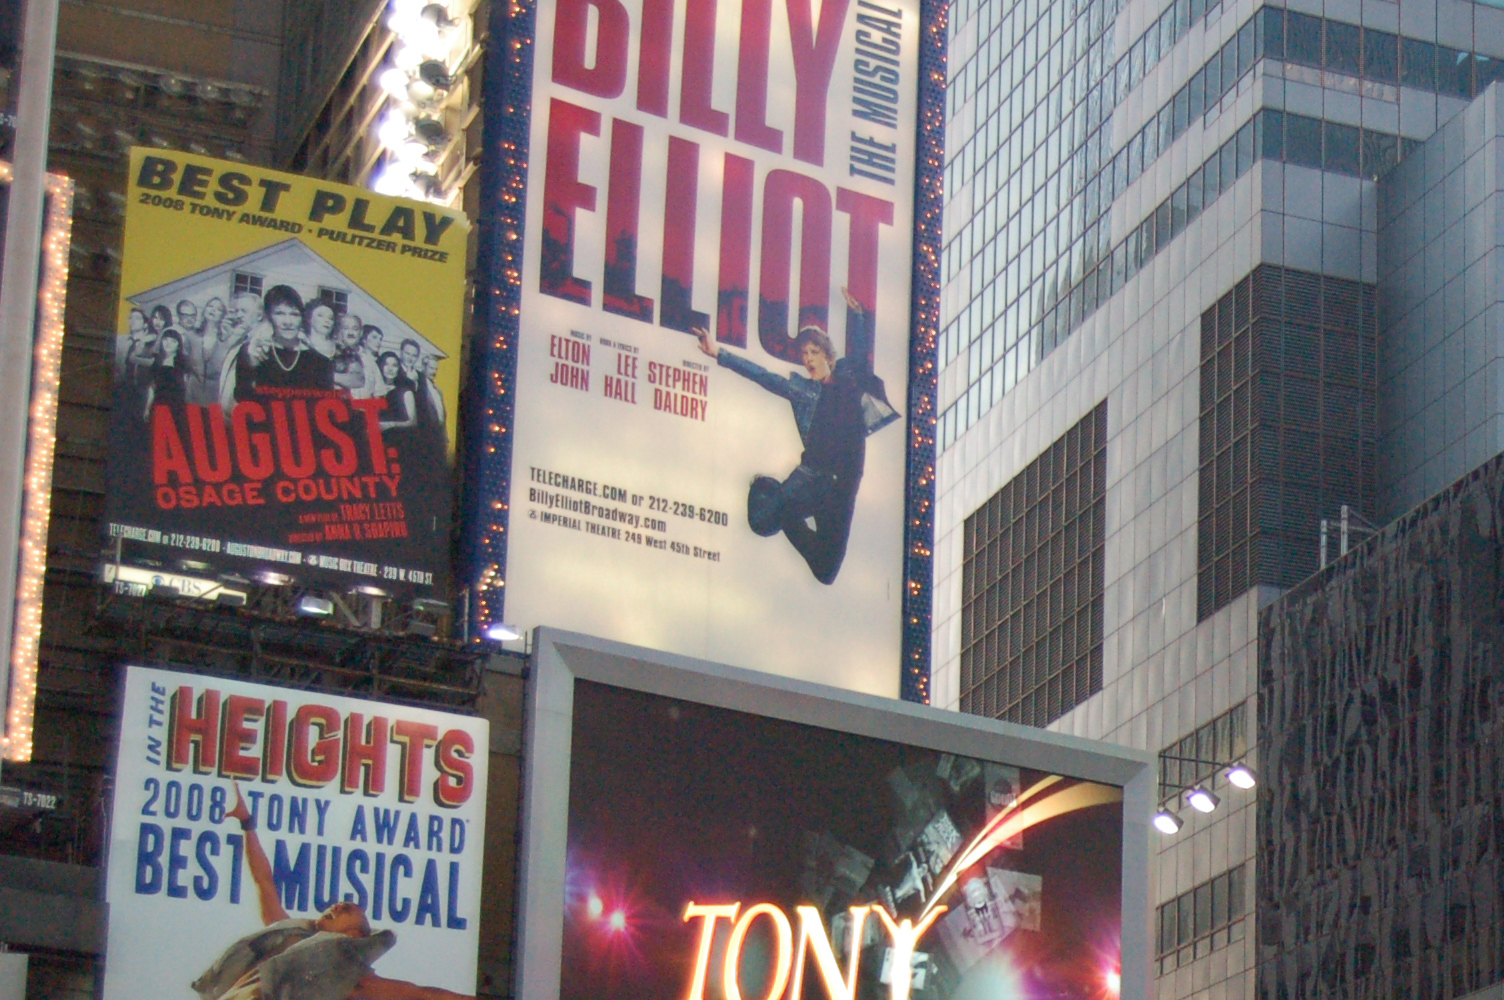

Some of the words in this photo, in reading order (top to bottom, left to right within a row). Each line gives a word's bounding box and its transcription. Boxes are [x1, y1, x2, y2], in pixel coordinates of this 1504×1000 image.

[852, 0, 902, 130] MUSICAL
[849, 130, 896, 186] THE
[137, 156, 291, 213] BEST
[308, 190, 455, 246] PLAY
[139, 193, 184, 212] 2008
[189, 202, 236, 221] TONY
[238, 212, 303, 234] AWARD
[317, 227, 398, 254] PULITZER
[400, 244, 449, 264] PRIZE
[539, 97, 895, 372] ELLIOT
[550, 334, 590, 366] ELTON
[617, 352, 638, 379] LEE
[550, 362, 589, 391] JOHN
[604, 374, 637, 405] HALL
[648, 361, 708, 397] STEPHEN
[654, 387, 708, 422] DALDRY
[152, 397, 401, 484] AUGUST:
[156, 482, 266, 509] OSAGE
[276, 475, 400, 502] COUNTY
[529, 487, 666, 532] BillyElliotBroadway.com
[530, 466, 627, 503] TELECHARGE.COM
[632, 493, 644, 506] or
[648, 496, 728, 527] 212-239-6200
[540, 511, 581, 531] IMPERIAL
[585, 521, 621, 540] THEATRE
[645, 535, 667, 550] West
[670, 541, 690, 556] 45th
[693, 546, 720, 562] Street
[148, 681, 166, 728] THE
[145, 735, 162, 766] IN
[166, 686, 475, 808] HEIGHTS
[140, 777, 227, 824] 2008
[247, 789, 331, 837] TONY
[350, 804, 466, 855] AWARD
[135, 822, 244, 904] BEST
[272, 838, 468, 930] MUSICAL
